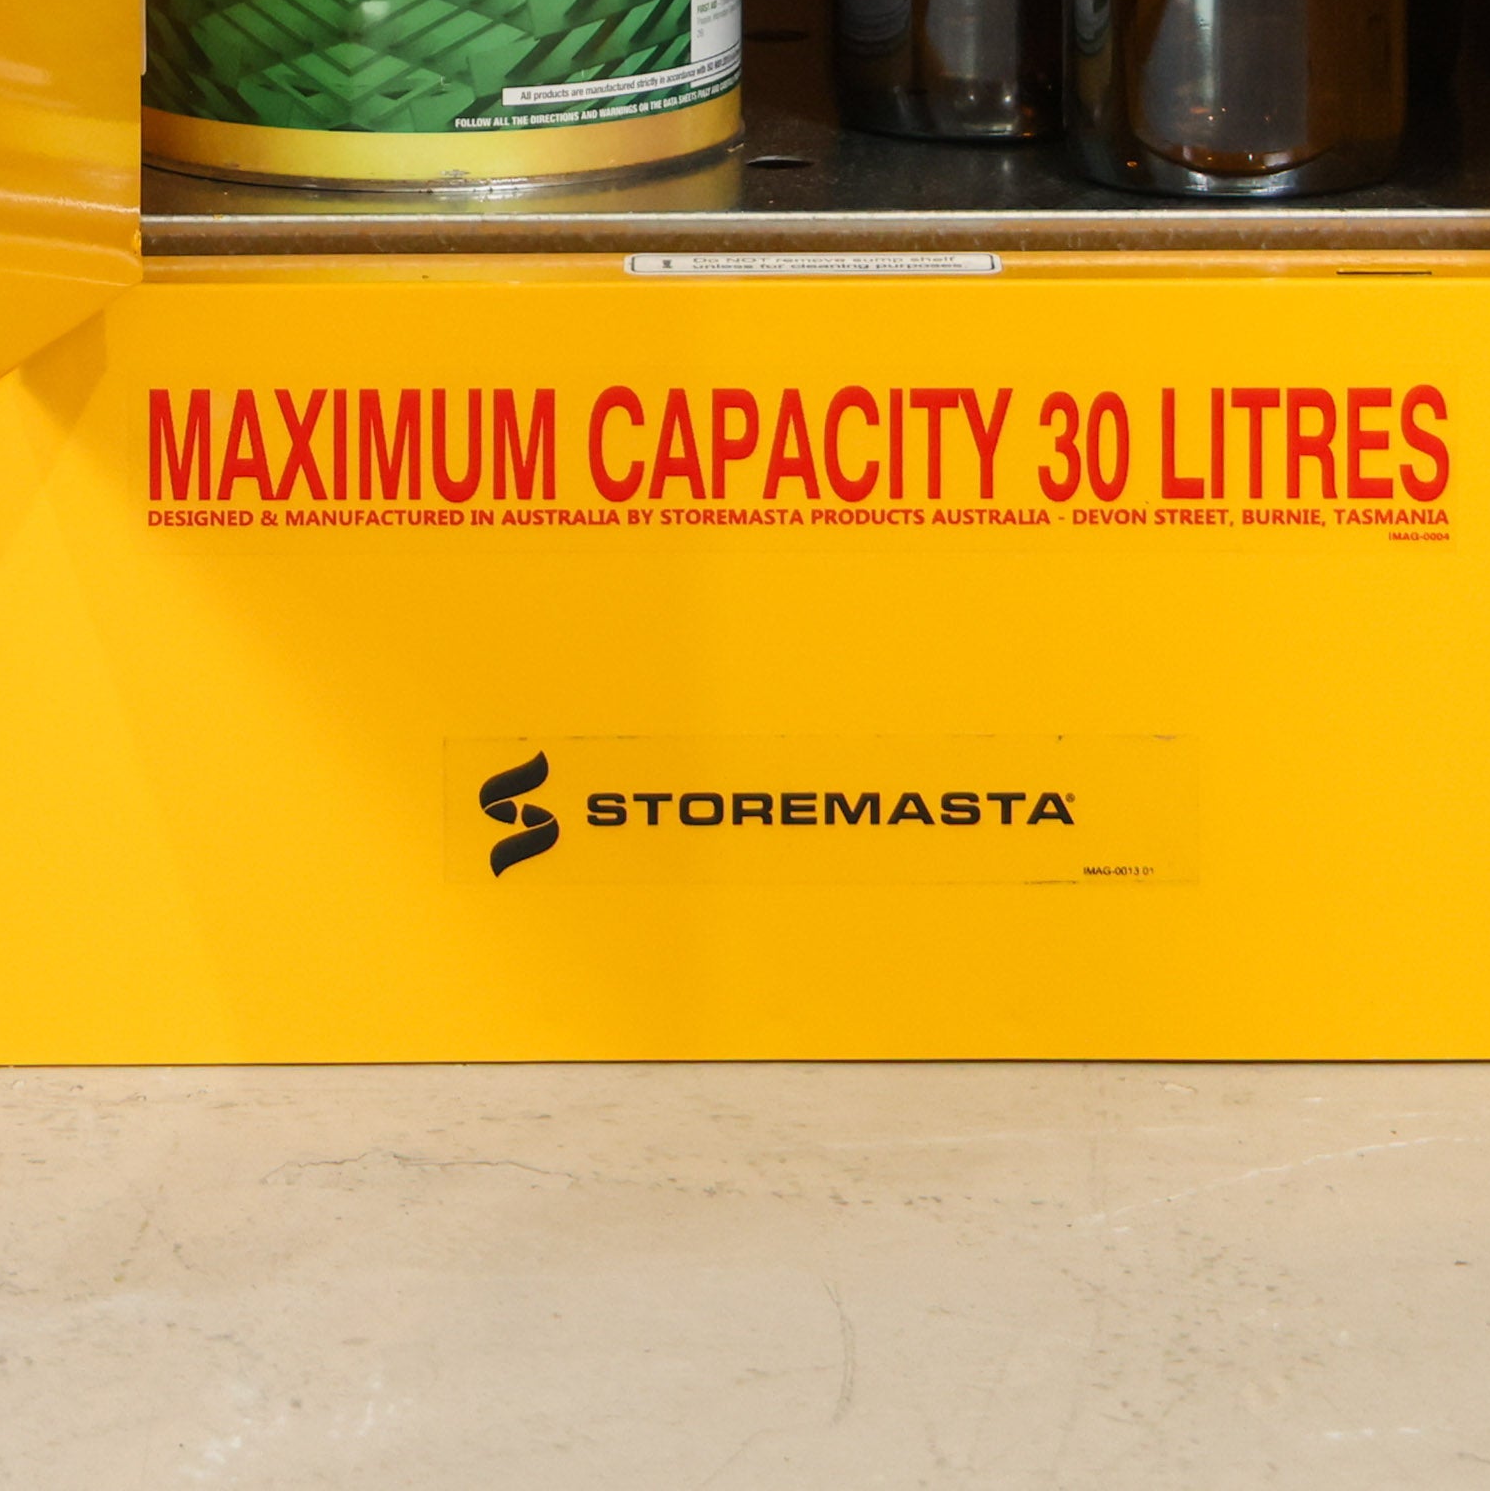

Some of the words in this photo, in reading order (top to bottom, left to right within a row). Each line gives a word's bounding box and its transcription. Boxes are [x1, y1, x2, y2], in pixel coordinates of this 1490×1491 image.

[520, 91, 531, 100] All
[533, 88, 569, 102] products
[571, 89, 584, 97] are
[585, 80, 635, 95] manufactured
[636, 77, 658, 88] strictly
[659, 75, 666, 84] in
[666, 70, 696, 84] accordance
[455, 118, 491, 128] FOLLOW
[493, 117, 510, 126] ALL
[512, 115, 529, 125] THE
[530, 111, 579, 124] DIRECTIONS
[581, 109, 598, 120] AND
[599, 104, 638, 118] WARNINGS
[639, 102, 649, 113] ON
[650, 100, 662, 110] THE
[663, 96, 678, 108] DATA
[678, 91, 697, 105] SHEETS
[148, 388, 556, 503] MAXIMUM
[588, 385, 1013, 503] CAPACITY
[1037, 390, 1130, 504] 30
[1161, 384, 1450, 503] LITRES
[147, 509, 254, 527] DESIGNED
[260, 509, 278, 527] &
[285, 509, 465, 527] MANUFACTURED
[471, 509, 495, 527] IN
[501, 509, 621, 527] AUSTRALIA
[627, 509, 653, 527] BY
[659, 509, 805, 527] STOREMASTA
[811, 508, 925, 527] PRODUCTS
[931, 508, 1051, 526] AUSTRALIA
[1071, 508, 1148, 526] DEVON
[1154, 508, 1235, 528] STREET,
[1242, 508, 1327, 528] BURNIE,
[1334, 508, 1450, 526] TASMANIA
[1083, 866, 1140, 876] IMAG-0013
[1142, 866, 1154, 876] 01
